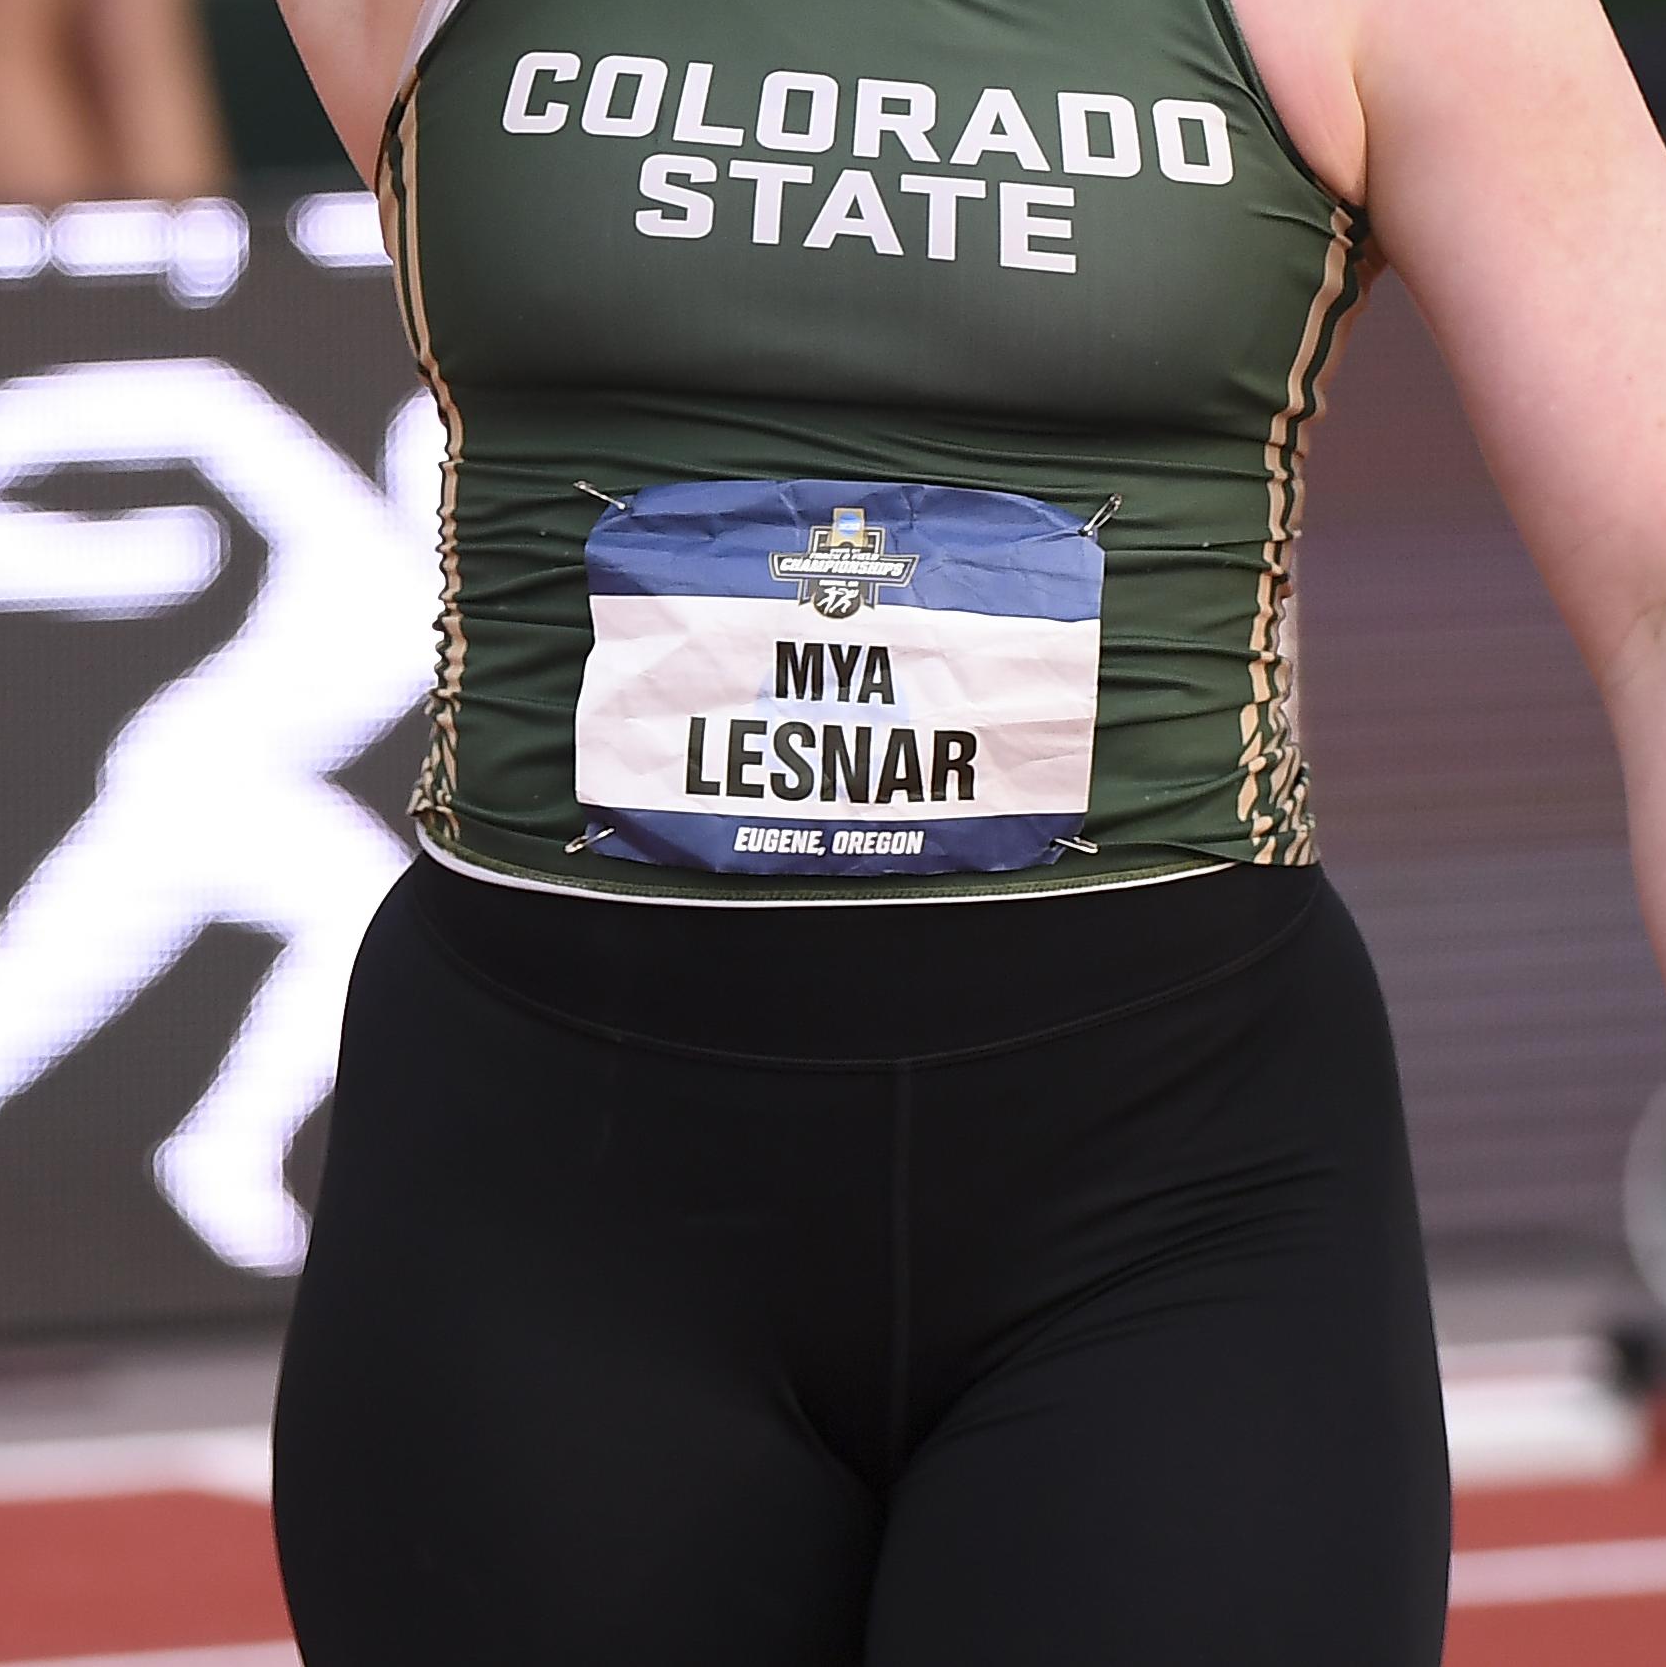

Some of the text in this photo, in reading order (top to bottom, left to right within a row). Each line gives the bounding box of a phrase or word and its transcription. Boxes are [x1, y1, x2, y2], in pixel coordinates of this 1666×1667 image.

[502, 51, 1235, 186] COLORADO
[634, 153, 1077, 274] STATE
[779, 557, 905, 576] CHAMPIONSHIPS
[776, 641, 895, 705] MYA
[686, 717, 977, 804] LESNAR
[734, 827, 924, 856] EUGENE, OREGON
